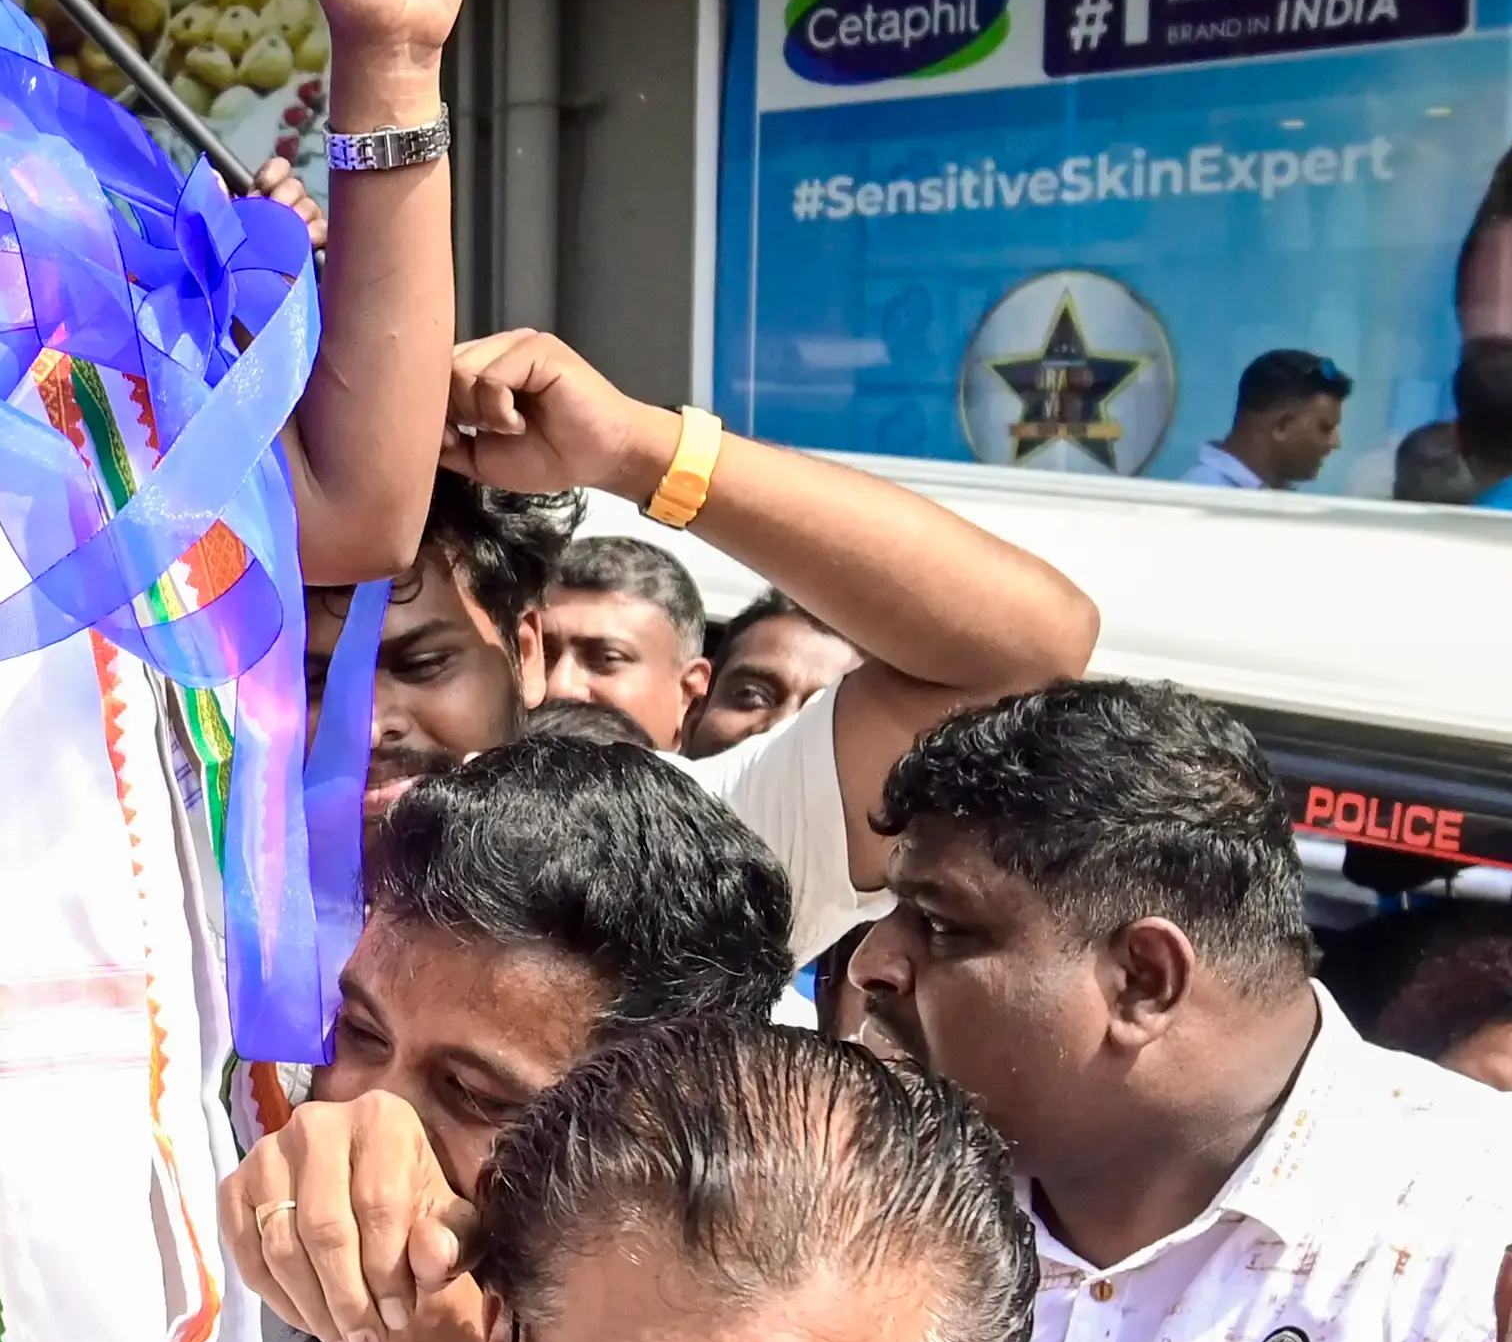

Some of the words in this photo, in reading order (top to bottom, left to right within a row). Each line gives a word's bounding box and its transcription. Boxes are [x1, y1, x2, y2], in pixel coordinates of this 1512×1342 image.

[1167, 18, 1242, 45] BRAND
[1248, 15, 1270, 35] IN
[792, 135, 1394, 221] #SensitiveSkinExpert
[1305, 785, 1464, 852] POLICE
